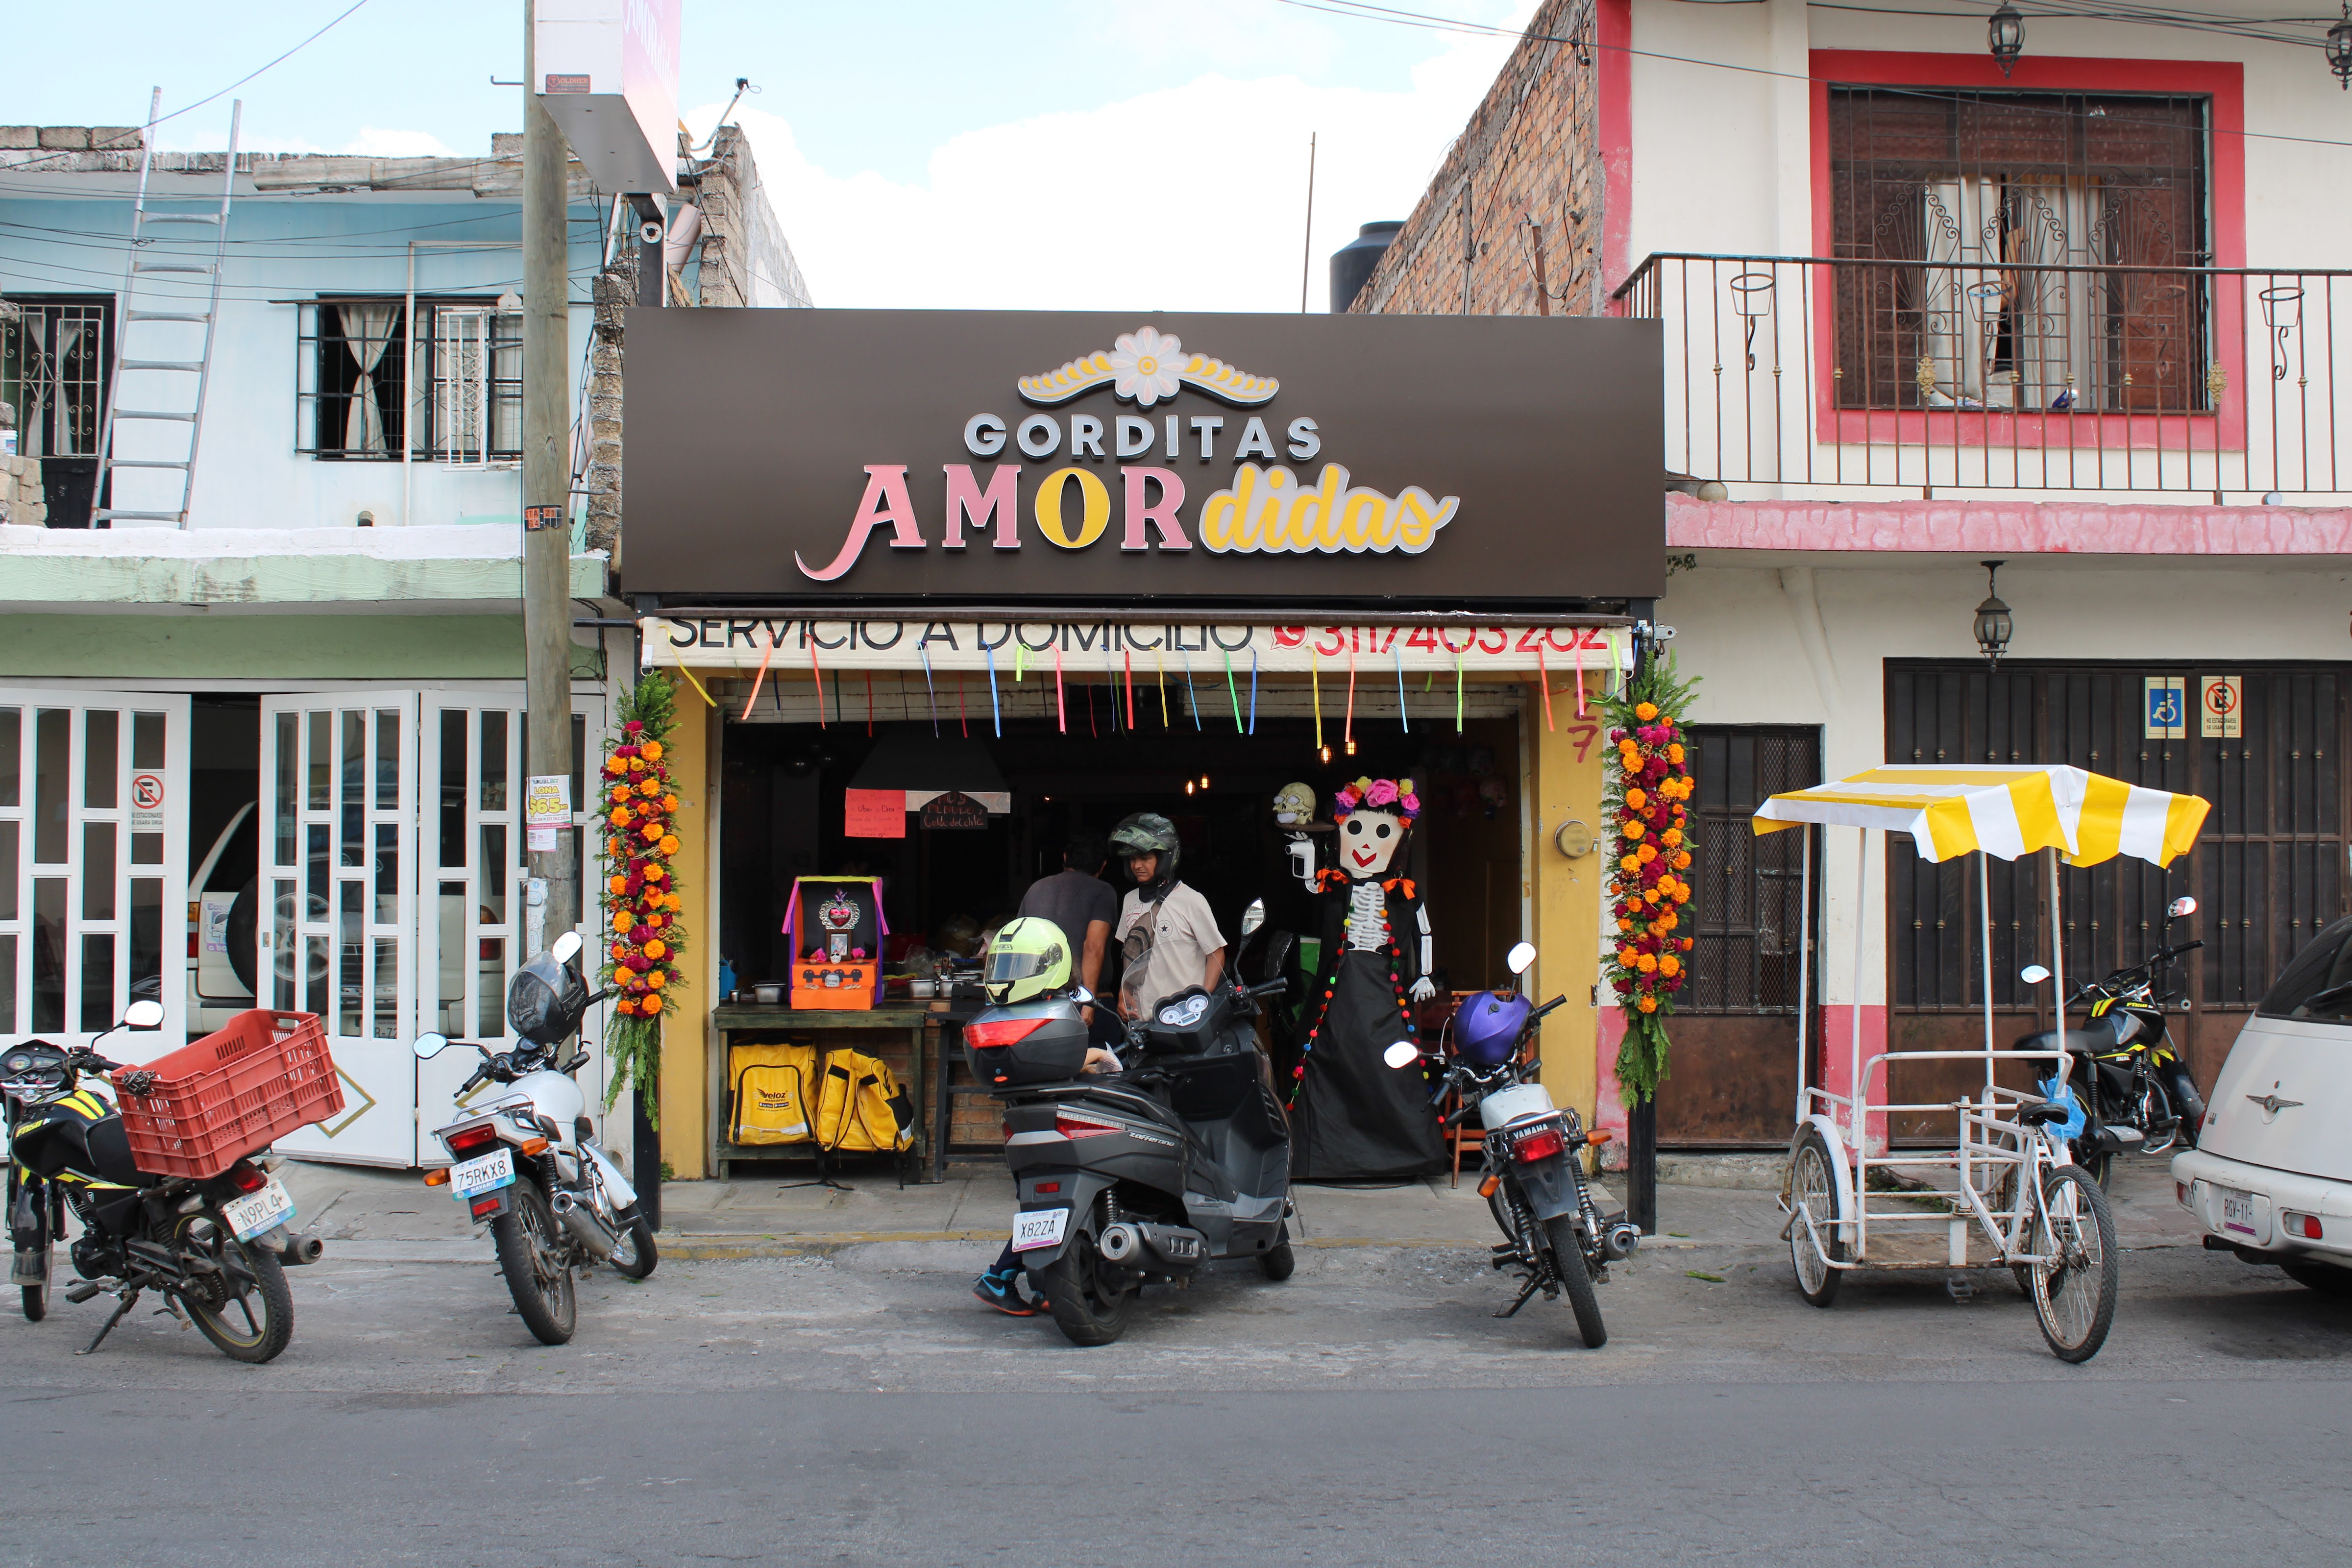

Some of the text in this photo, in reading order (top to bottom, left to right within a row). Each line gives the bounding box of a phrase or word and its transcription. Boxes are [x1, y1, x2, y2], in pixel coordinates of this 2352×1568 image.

[964, 414, 1322, 460] GORDITAS
[669, 619, 903, 650] SERVICIO
[918, 621, 959, 651] A
[978, 622, 1253, 651] DOMICILIO
[534, 786, 560, 794] LONA
[528, 795, 561, 817] $65
[1513, 1123, 1548, 1139] YAMAHA
[468, 1155, 490, 1166] NAYARIT
[458, 1160, 506, 1189] 75RKX8
[470, 1180, 497, 1192] NAYARIT
[2225, 1199, 2252, 1221] RGV-11-
[254, 1214, 279, 1231] NAYARIT
[1020, 1220, 1055, 1239] X82ZA
